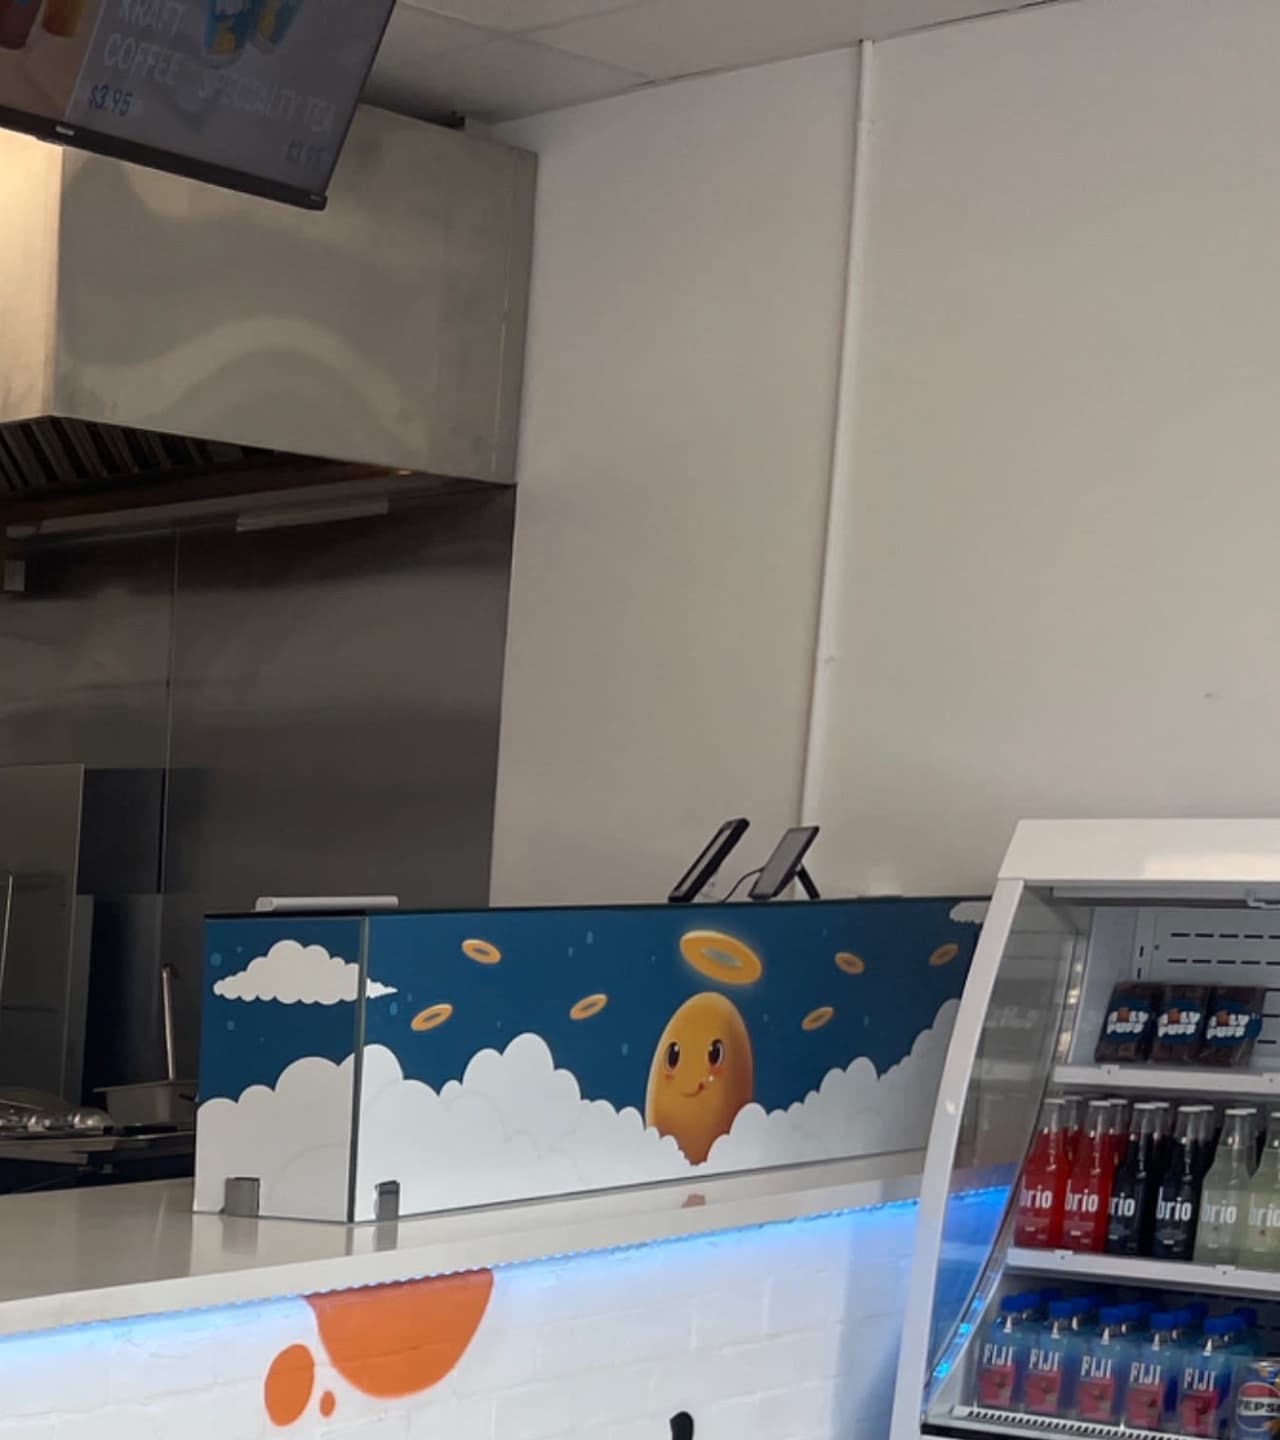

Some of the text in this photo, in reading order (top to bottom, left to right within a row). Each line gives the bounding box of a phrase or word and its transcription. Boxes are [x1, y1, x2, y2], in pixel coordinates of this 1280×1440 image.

[102, 33, 182, 87] COFFEE
[1106, 1022, 1144, 1035] PUFF
[1157, 1024, 1196, 1038] PUFF
[1206, 1026, 1246, 1040] PUFF
[1019, 1175, 1053, 1209] brio
[1064, 1179, 1098, 1213] brio
[1156, 1186, 1191, 1221] brio
[1109, 1192, 1135, 1217] rio
[1201, 1189, 1238, 1224] brio
[983, 1343, 1015, 1366] FIJI
[1029, 1349, 1060, 1371] FIJI
[1081, 1355, 1112, 1379] FIJI
[1130, 1362, 1161, 1386] FIJI
[1183, 1368, 1217, 1391] FIJI
